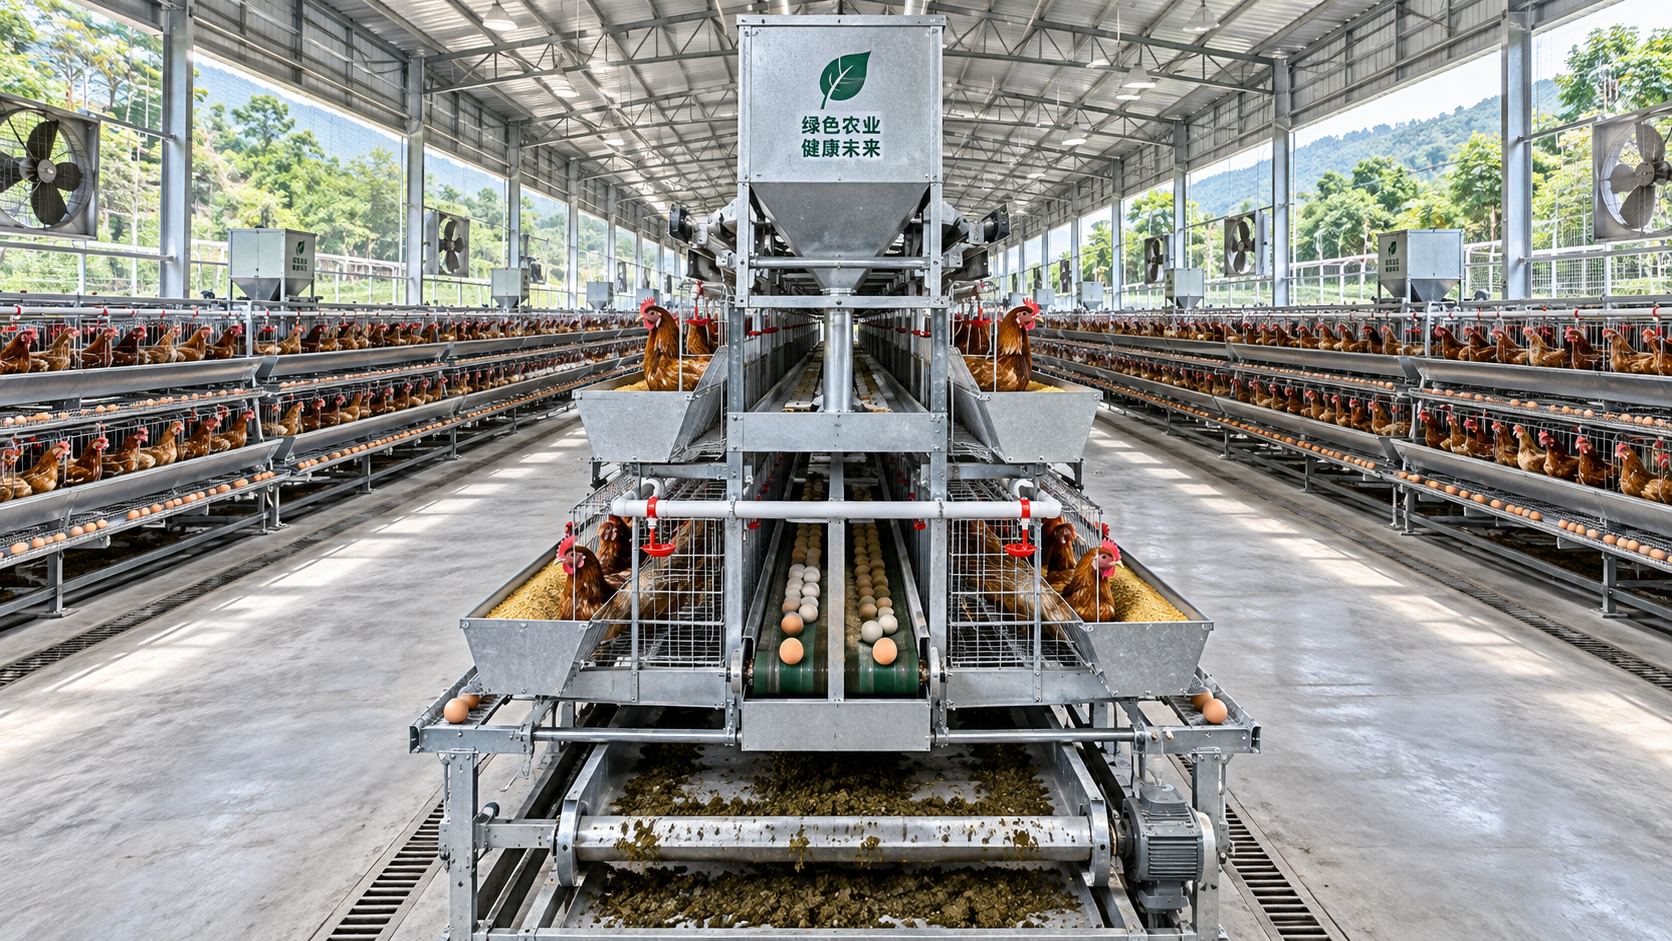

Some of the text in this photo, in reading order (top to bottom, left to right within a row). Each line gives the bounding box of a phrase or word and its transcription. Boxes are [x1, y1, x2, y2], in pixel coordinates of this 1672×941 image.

[801, 115, 881, 135] 绿色农业
[801, 138, 881, 158] 健康未来
